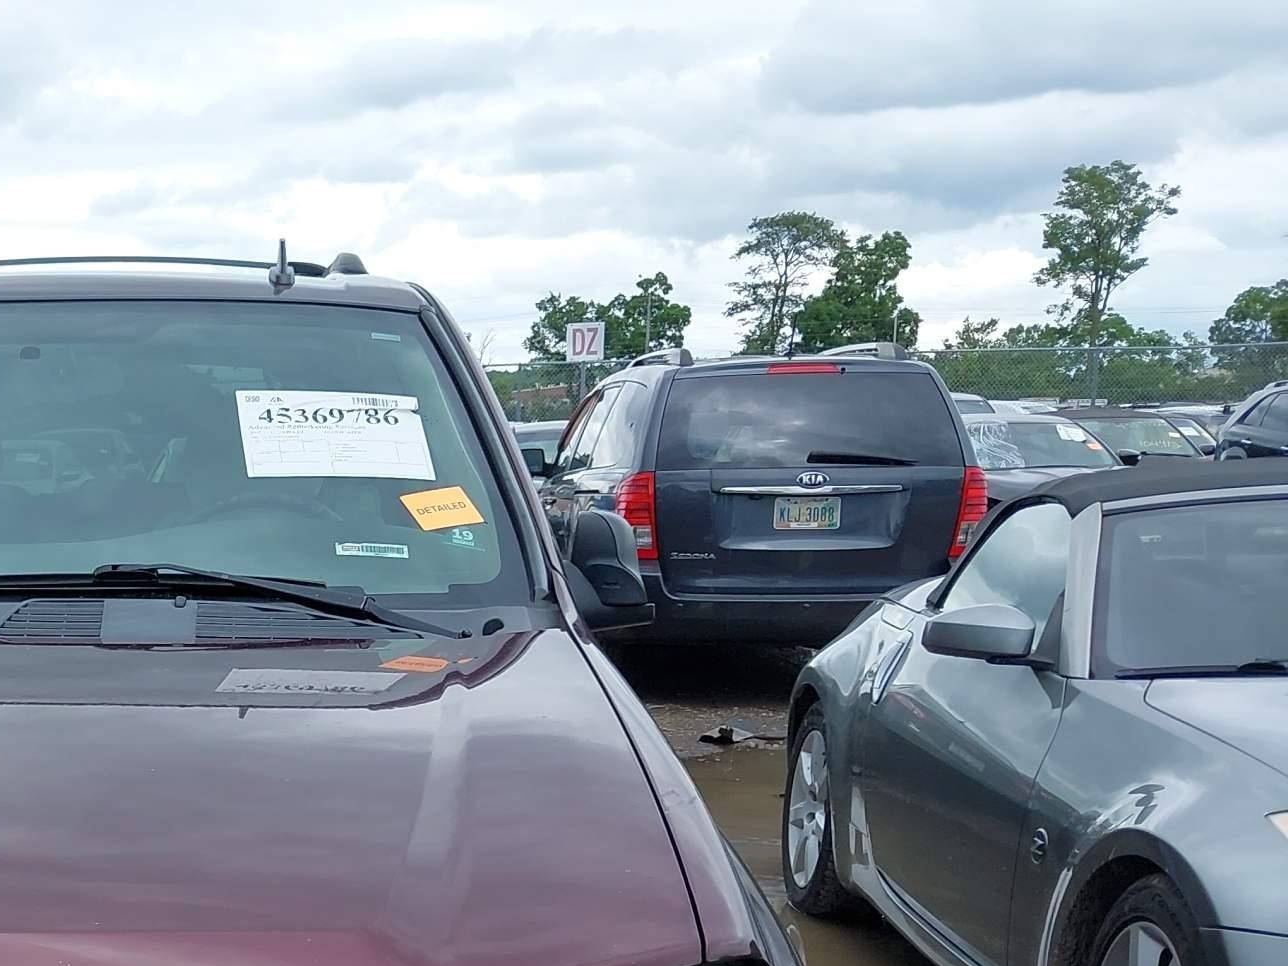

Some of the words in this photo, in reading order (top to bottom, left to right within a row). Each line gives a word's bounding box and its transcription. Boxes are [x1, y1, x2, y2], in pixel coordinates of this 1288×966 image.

[572, 327, 599, 356] DZ
[258, 407, 400, 425] 45369786
[802, 475, 824, 485] KIA
[416, 501, 467, 516] DETAILED
[779, 507, 801, 523] KLJ
[452, 528, 474, 541] 19
